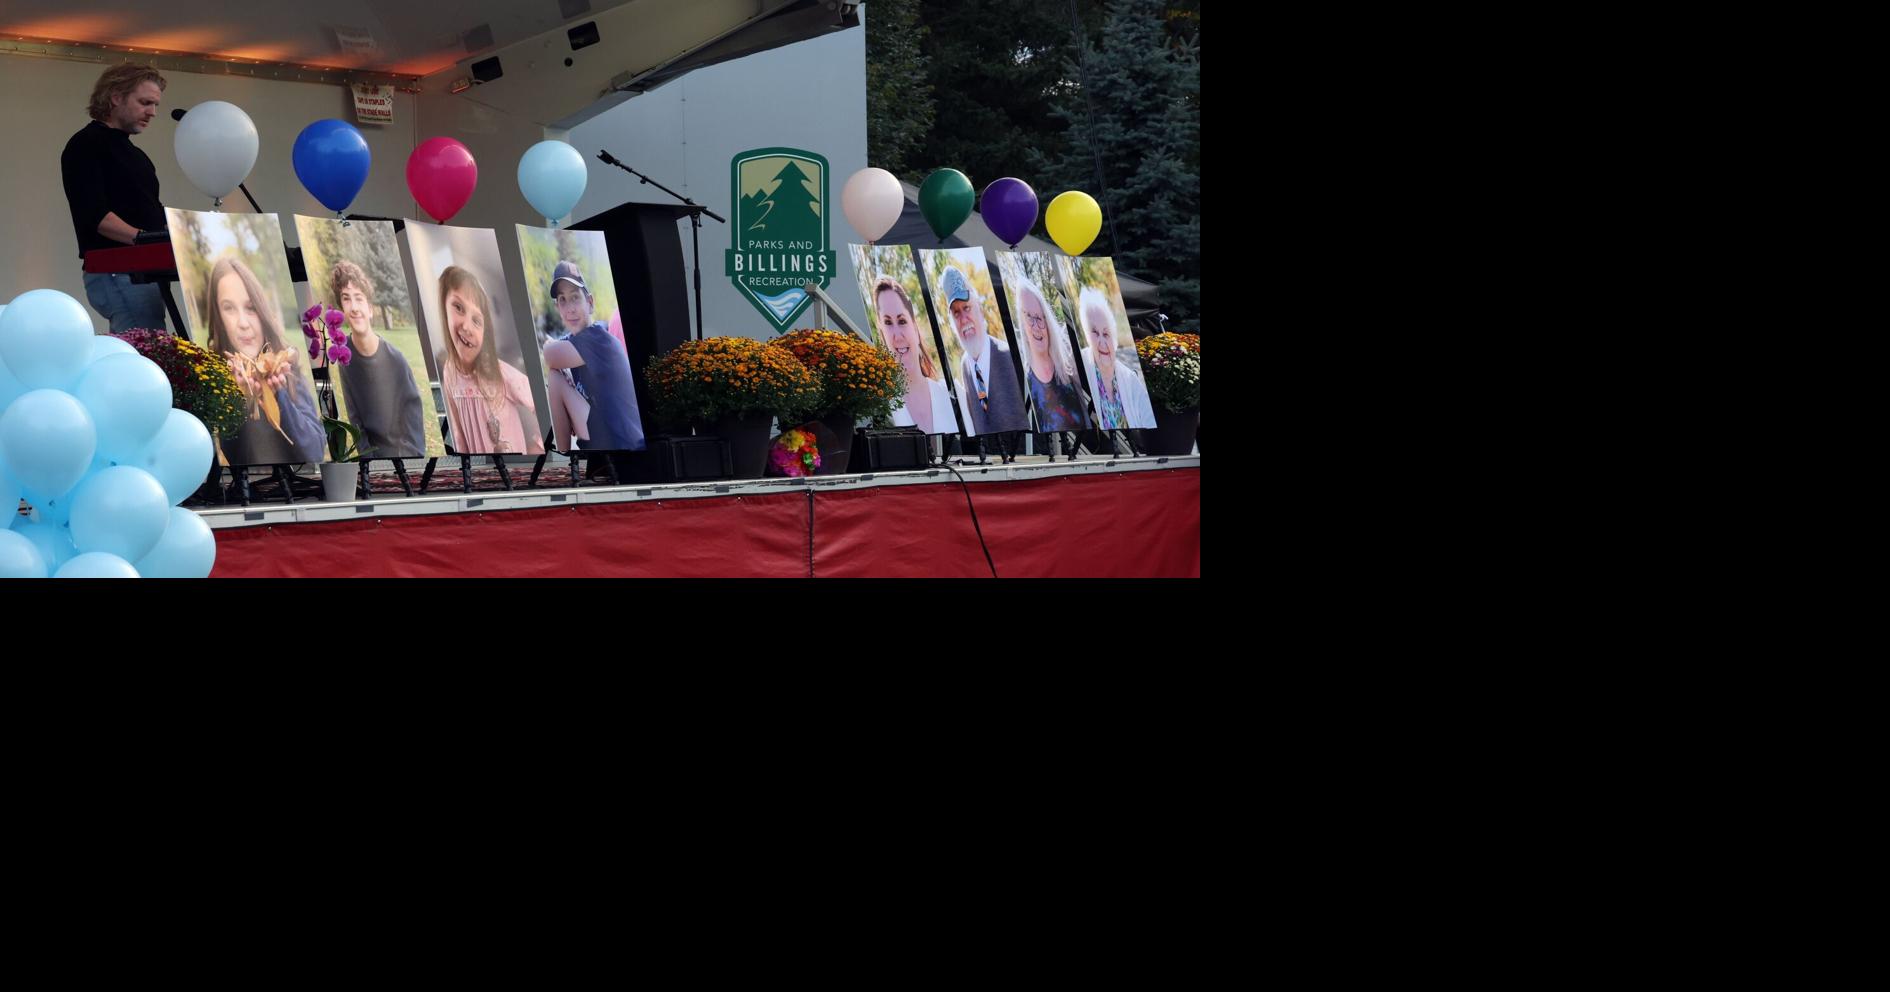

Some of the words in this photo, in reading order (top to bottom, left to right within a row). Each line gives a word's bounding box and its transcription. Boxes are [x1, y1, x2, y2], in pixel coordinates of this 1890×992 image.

[749, 240, 784, 249] PARKS
[788, 240, 813, 250] AND
[734, 253, 828, 273] BILLINGS
